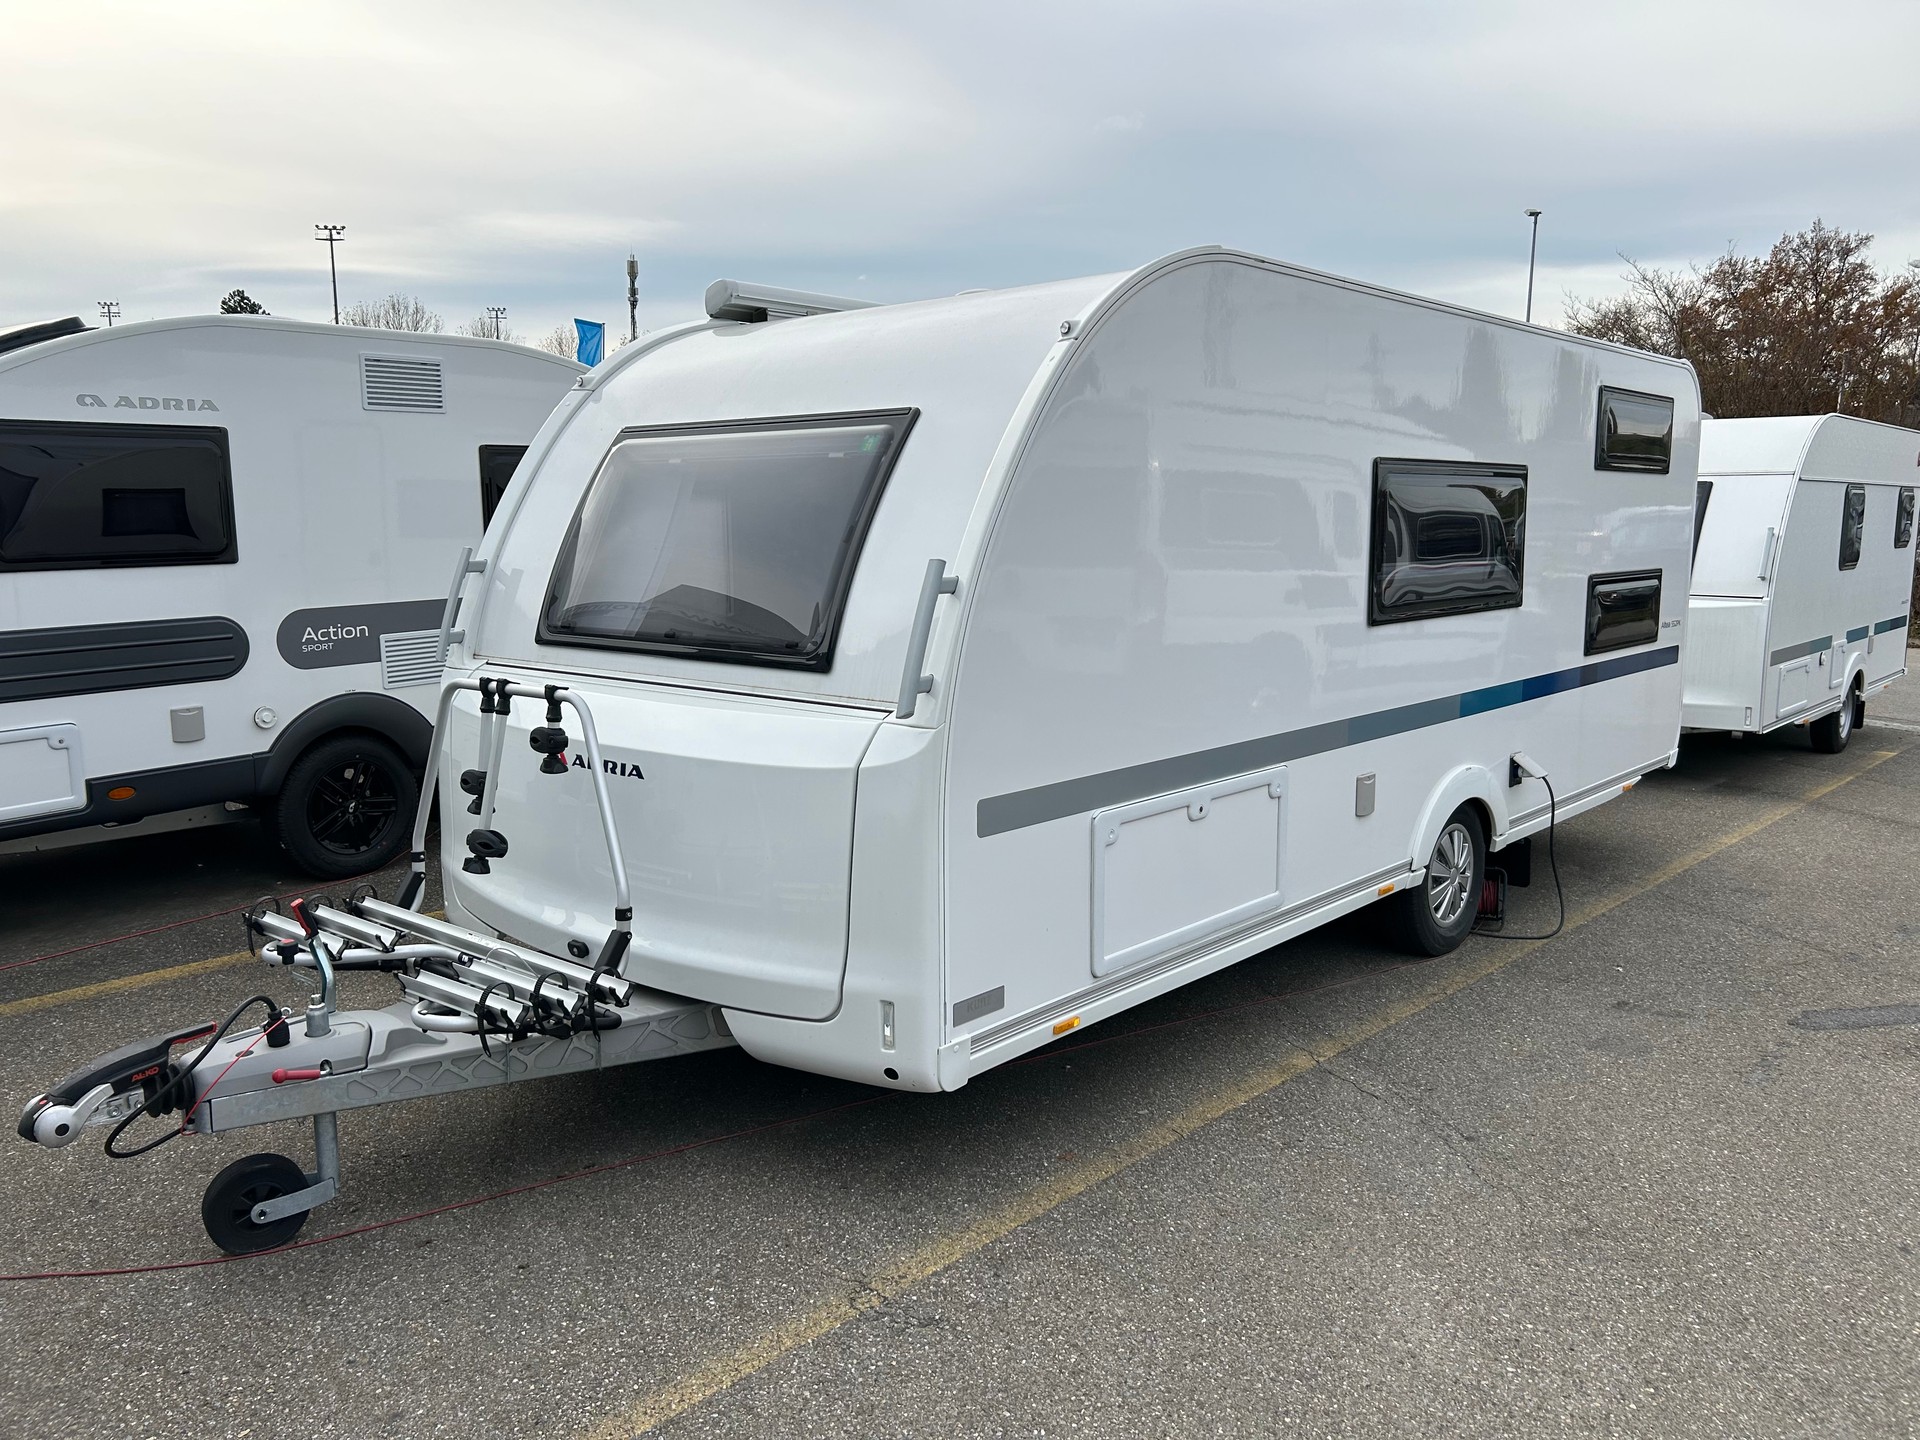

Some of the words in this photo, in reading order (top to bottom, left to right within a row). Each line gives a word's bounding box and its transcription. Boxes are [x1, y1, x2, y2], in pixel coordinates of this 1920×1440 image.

[114, 396, 219, 412] ADRIA
[301, 624, 369, 642] Action
[302, 642, 334, 652] SPORT
[572, 754, 645, 780] ARIA
